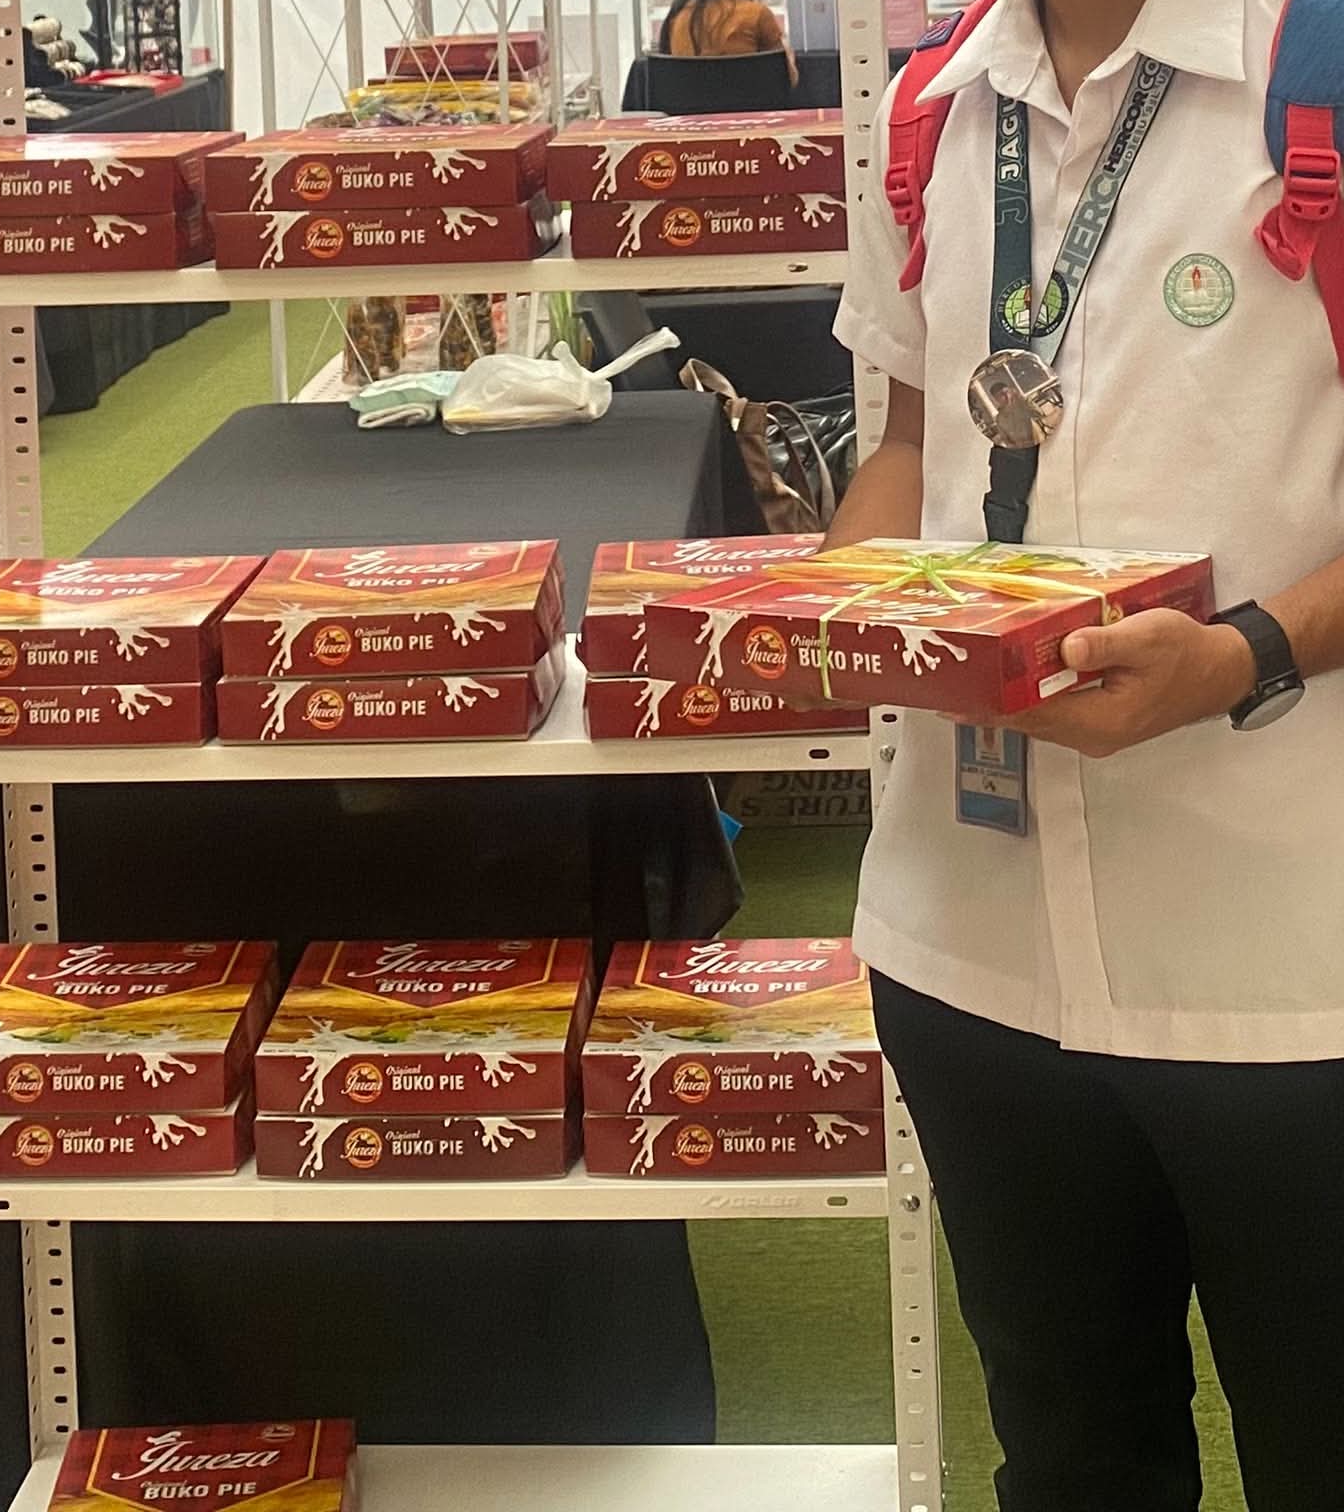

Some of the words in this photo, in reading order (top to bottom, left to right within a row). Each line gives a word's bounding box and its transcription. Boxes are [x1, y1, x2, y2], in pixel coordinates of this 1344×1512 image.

[1103, 89, 1146, 173] HERCOR
[686, 161, 729, 176] BUKO
[735, 160, 760, 175] PIE
[1, 181, 42, 196] BUKO
[49, 181, 72, 194] PIE
[342, 173, 384, 189] BUKO
[390, 172, 414, 187] PIE
[711, 218, 753, 233] BUKO
[759, 216, 784, 231] PIE
[4, 239, 45, 253] BUKO
[51, 238, 75, 252] PIE
[353, 230, 394, 246] BUKO
[401, 229, 425, 244] PIE
[687, 564, 752, 574] BUKO
[348, 577, 418, 587] BUKO
[422, 576, 460, 585] PIE
[39, 588, 103, 596] BUKO
[112, 587, 152, 595] PIE
[362, 636, 403, 652] BUKO
[409, 634, 434, 650] PIE
[27, 651, 68, 665] BUKO
[74, 650, 99, 664] PIE
[799, 648, 847, 670] BUKO
[853, 652, 882, 674] PIE
[354, 700, 396, 716] BUKO
[402, 699, 426, 715] PIE
[730, 696, 772, 712] BUKO
[30, 709, 71, 724] BUKO
[76, 708, 100, 723] PIE
[56, 984, 120, 995] BUKO
[128, 984, 168, 994] PIE
[378, 982, 443, 993] BUKO
[452, 982, 492, 992] PIE
[694, 982, 759, 993] BUKO
[768, 982, 808, 992] PIE
[53, 1076, 94, 1091] BUKO
[99, 1076, 125, 1090] PIE
[392, 1075, 434, 1091] BUKO
[440, 1074, 465, 1090] PIE
[721, 1074, 763, 1091] BUKO
[769, 1074, 793, 1090] PIE
[63, 1138, 104, 1154] BUKO
[110, 1138, 134, 1152] PIE
[392, 1140, 434, 1156] BUKO
[440, 1140, 464, 1154] PIE
[723, 1137, 766, 1153] BUKO
[772, 1137, 796, 1152] PIE
[144, 1484, 208, 1500] BUKO
[218, 1482, 256, 1495] PIE
